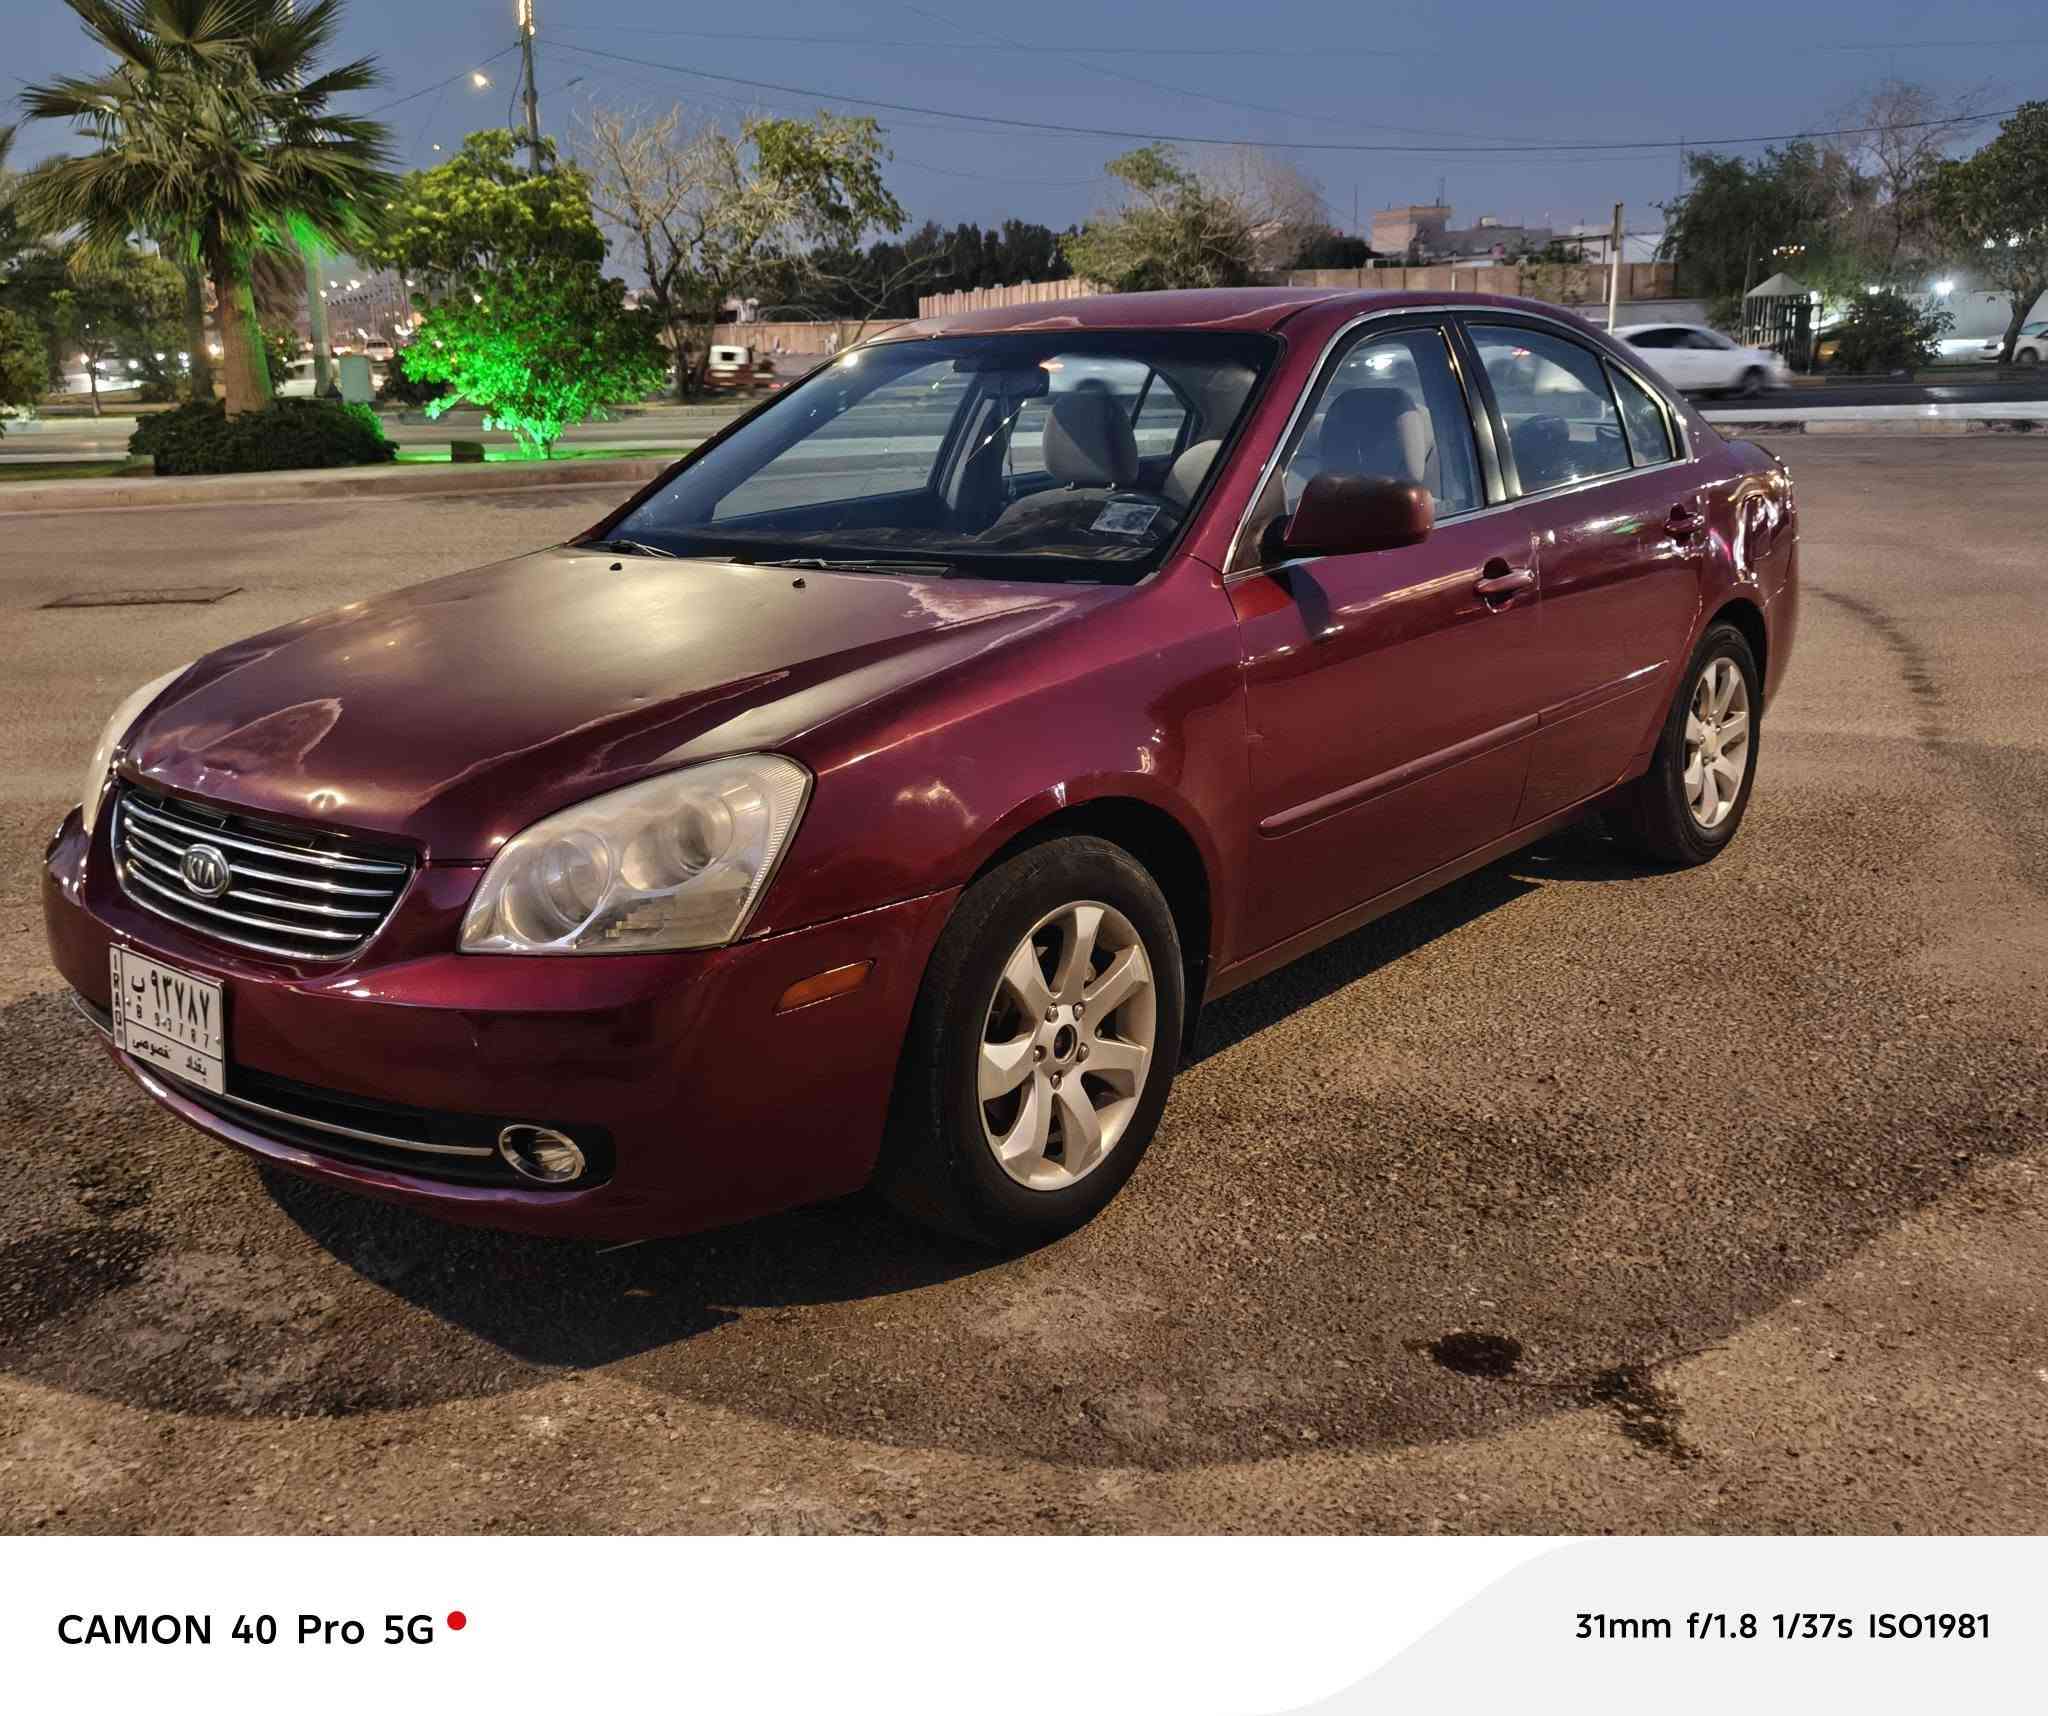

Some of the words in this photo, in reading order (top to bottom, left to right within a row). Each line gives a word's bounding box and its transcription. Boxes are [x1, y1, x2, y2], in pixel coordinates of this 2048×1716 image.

[113, 953, 122, 1027] IRAQ
[131, 974, 146, 1002] ب
[151, 969, 210, 1031] ٩٣٧٨٧
